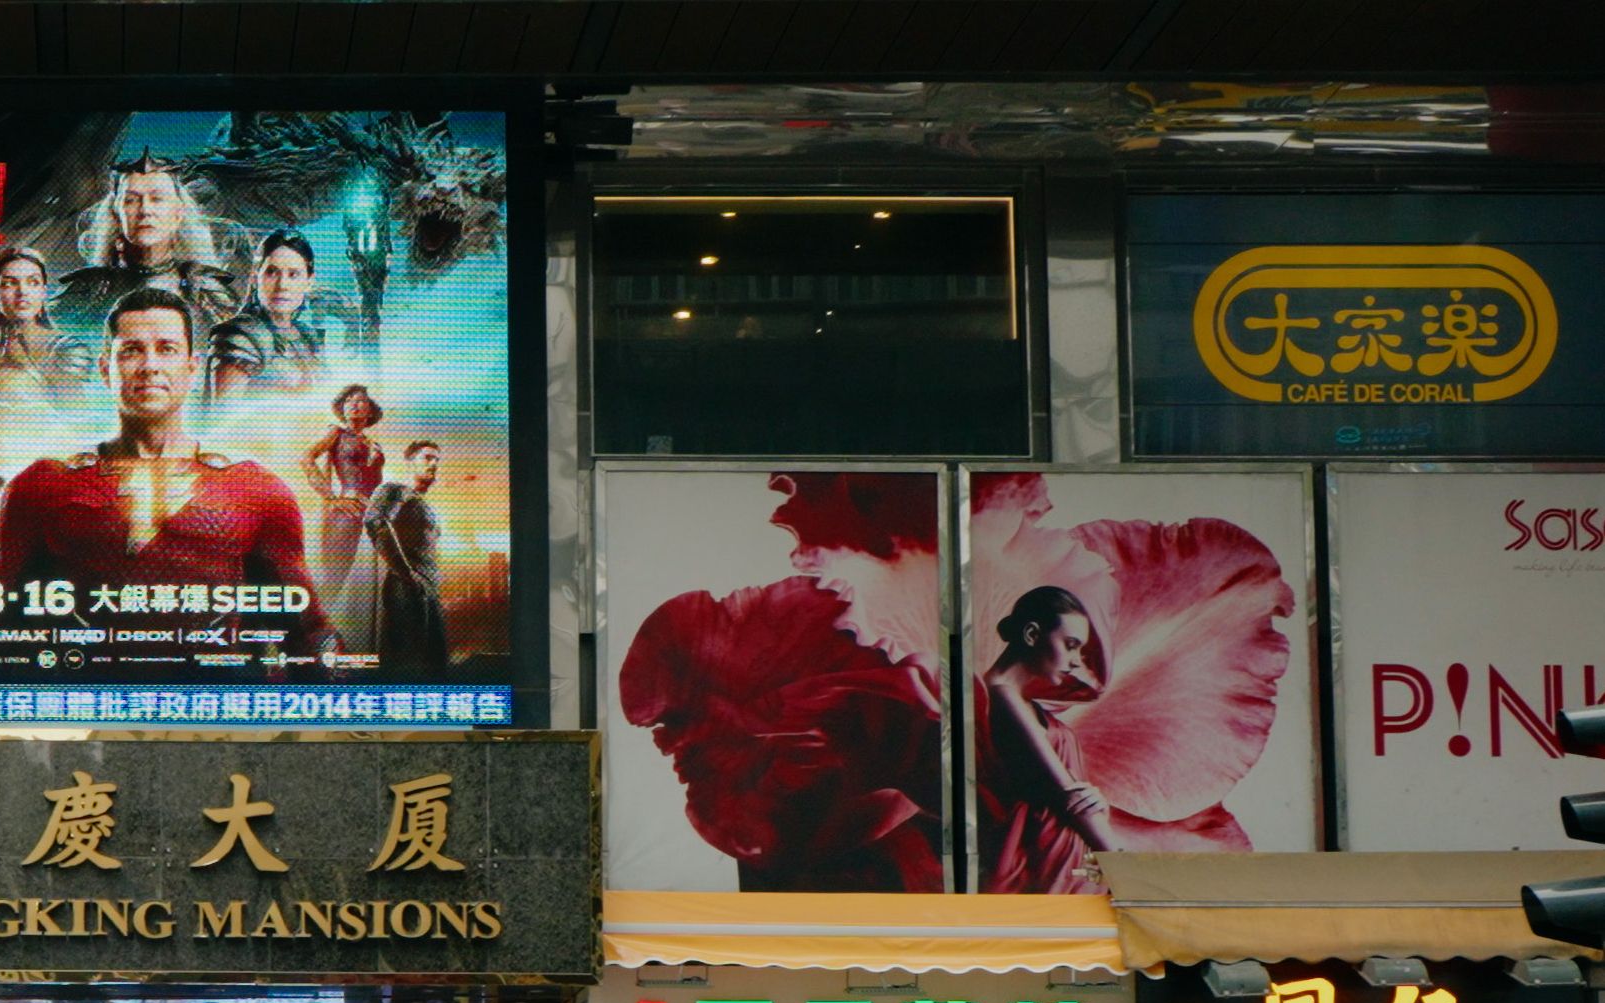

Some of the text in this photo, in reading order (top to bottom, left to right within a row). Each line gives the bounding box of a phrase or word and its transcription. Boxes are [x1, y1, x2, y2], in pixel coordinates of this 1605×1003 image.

[1287, 380, 1470, 403] CAFÉ DE CORAL
[1505, 499, 1605, 551] Sas
[89, 583, 311, 614] 大銀幕爆SEED
[197, 899, 502, 941] MANSIONS
